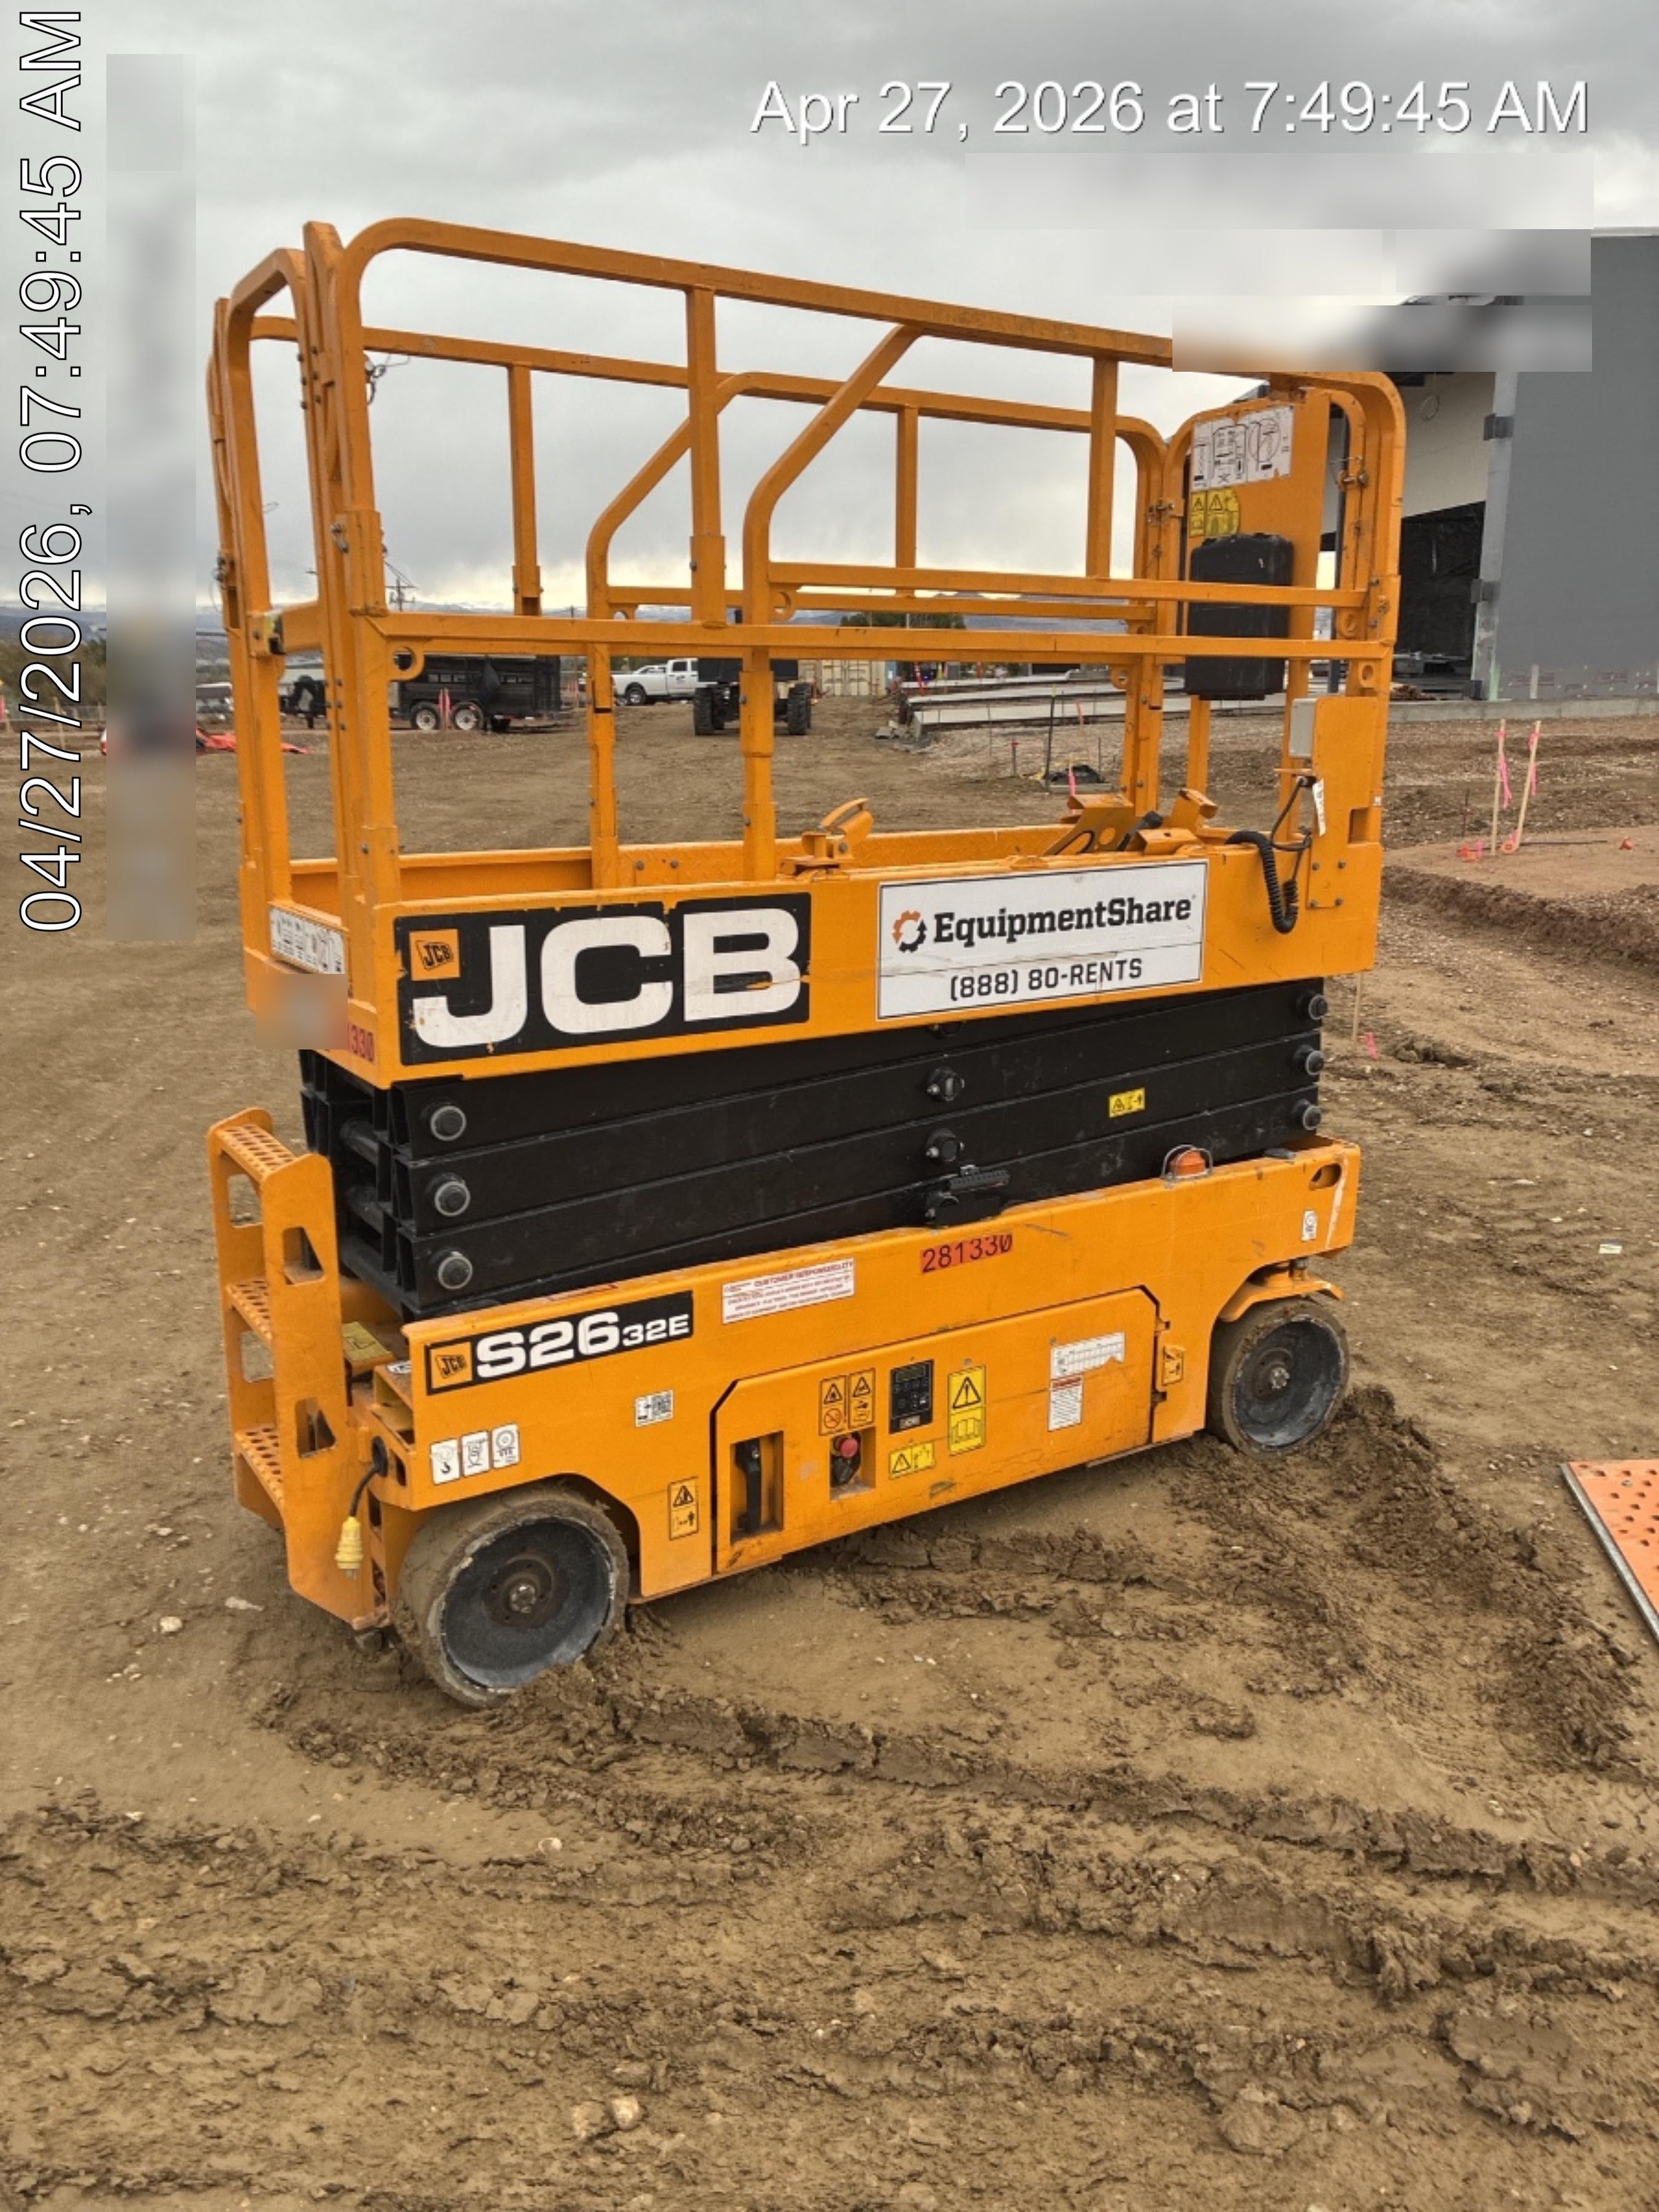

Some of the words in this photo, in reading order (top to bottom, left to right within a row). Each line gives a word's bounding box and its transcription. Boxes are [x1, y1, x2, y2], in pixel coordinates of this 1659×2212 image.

[932, 896, 1192, 947] EquipmentShare
[422, 943, 450, 967] JCB
[412, 908, 801, 1048] JCB
[950, 969, 1019, 1002] (888)
[1027, 957, 1143, 992] 80-RENTS
[922, 1234, 1013, 1274] 281330
